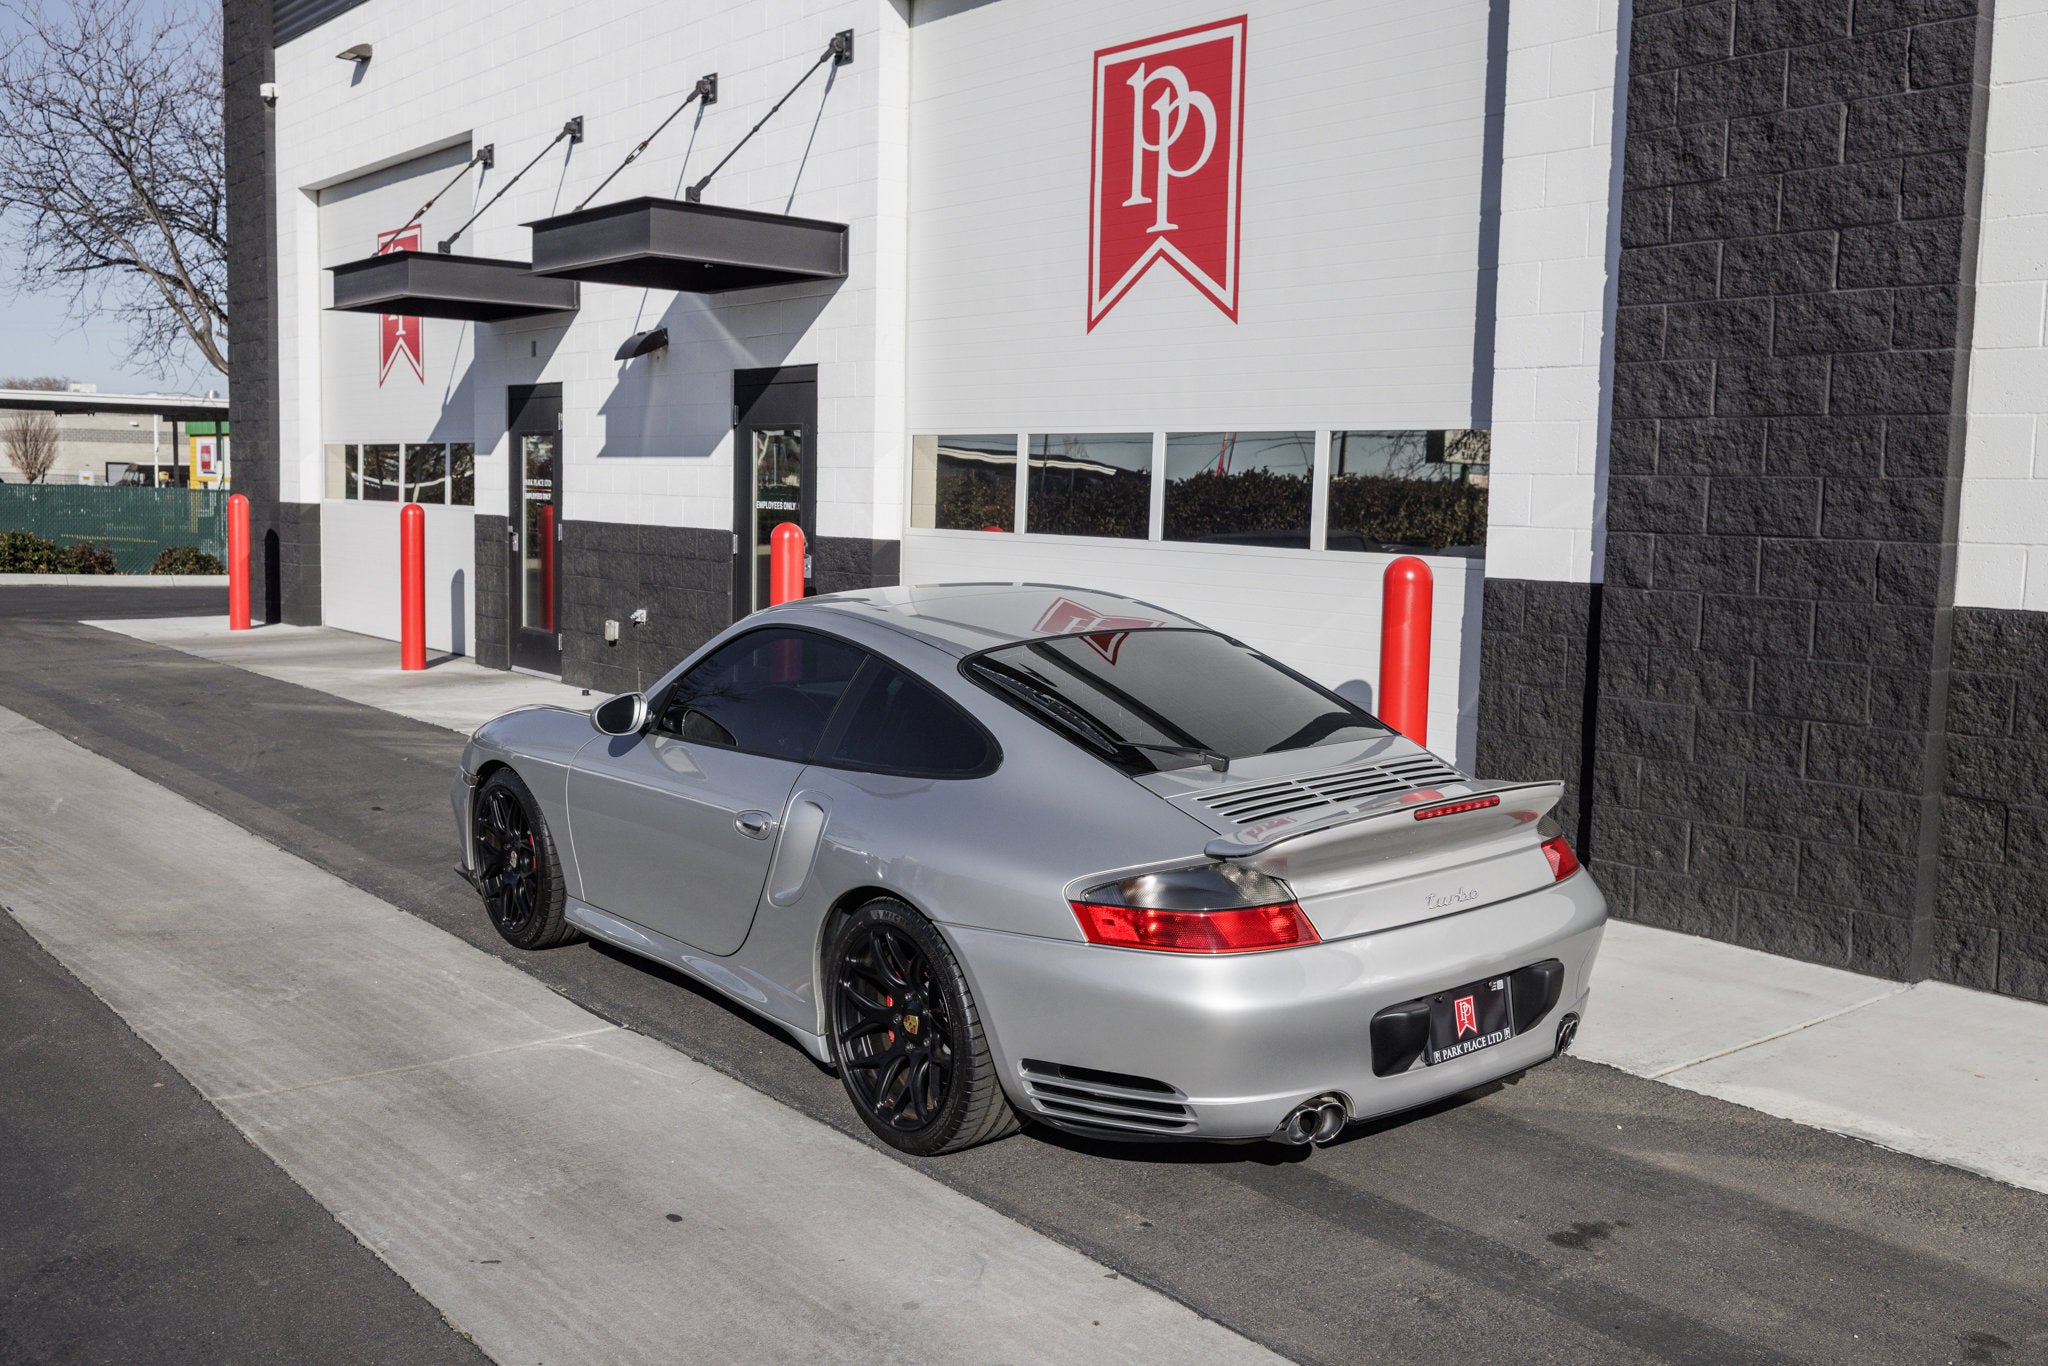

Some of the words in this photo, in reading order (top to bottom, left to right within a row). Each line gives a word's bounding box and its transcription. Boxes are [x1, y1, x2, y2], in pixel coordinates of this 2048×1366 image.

[756, 500, 782, 509] EMPLOYEES
[783, 502, 797, 510] ONLY
[1442, 1044, 1463, 1060] PARK
[1463, 1036, 1487, 1053] PLACE
[1488, 1031, 1503, 1046] LTD
